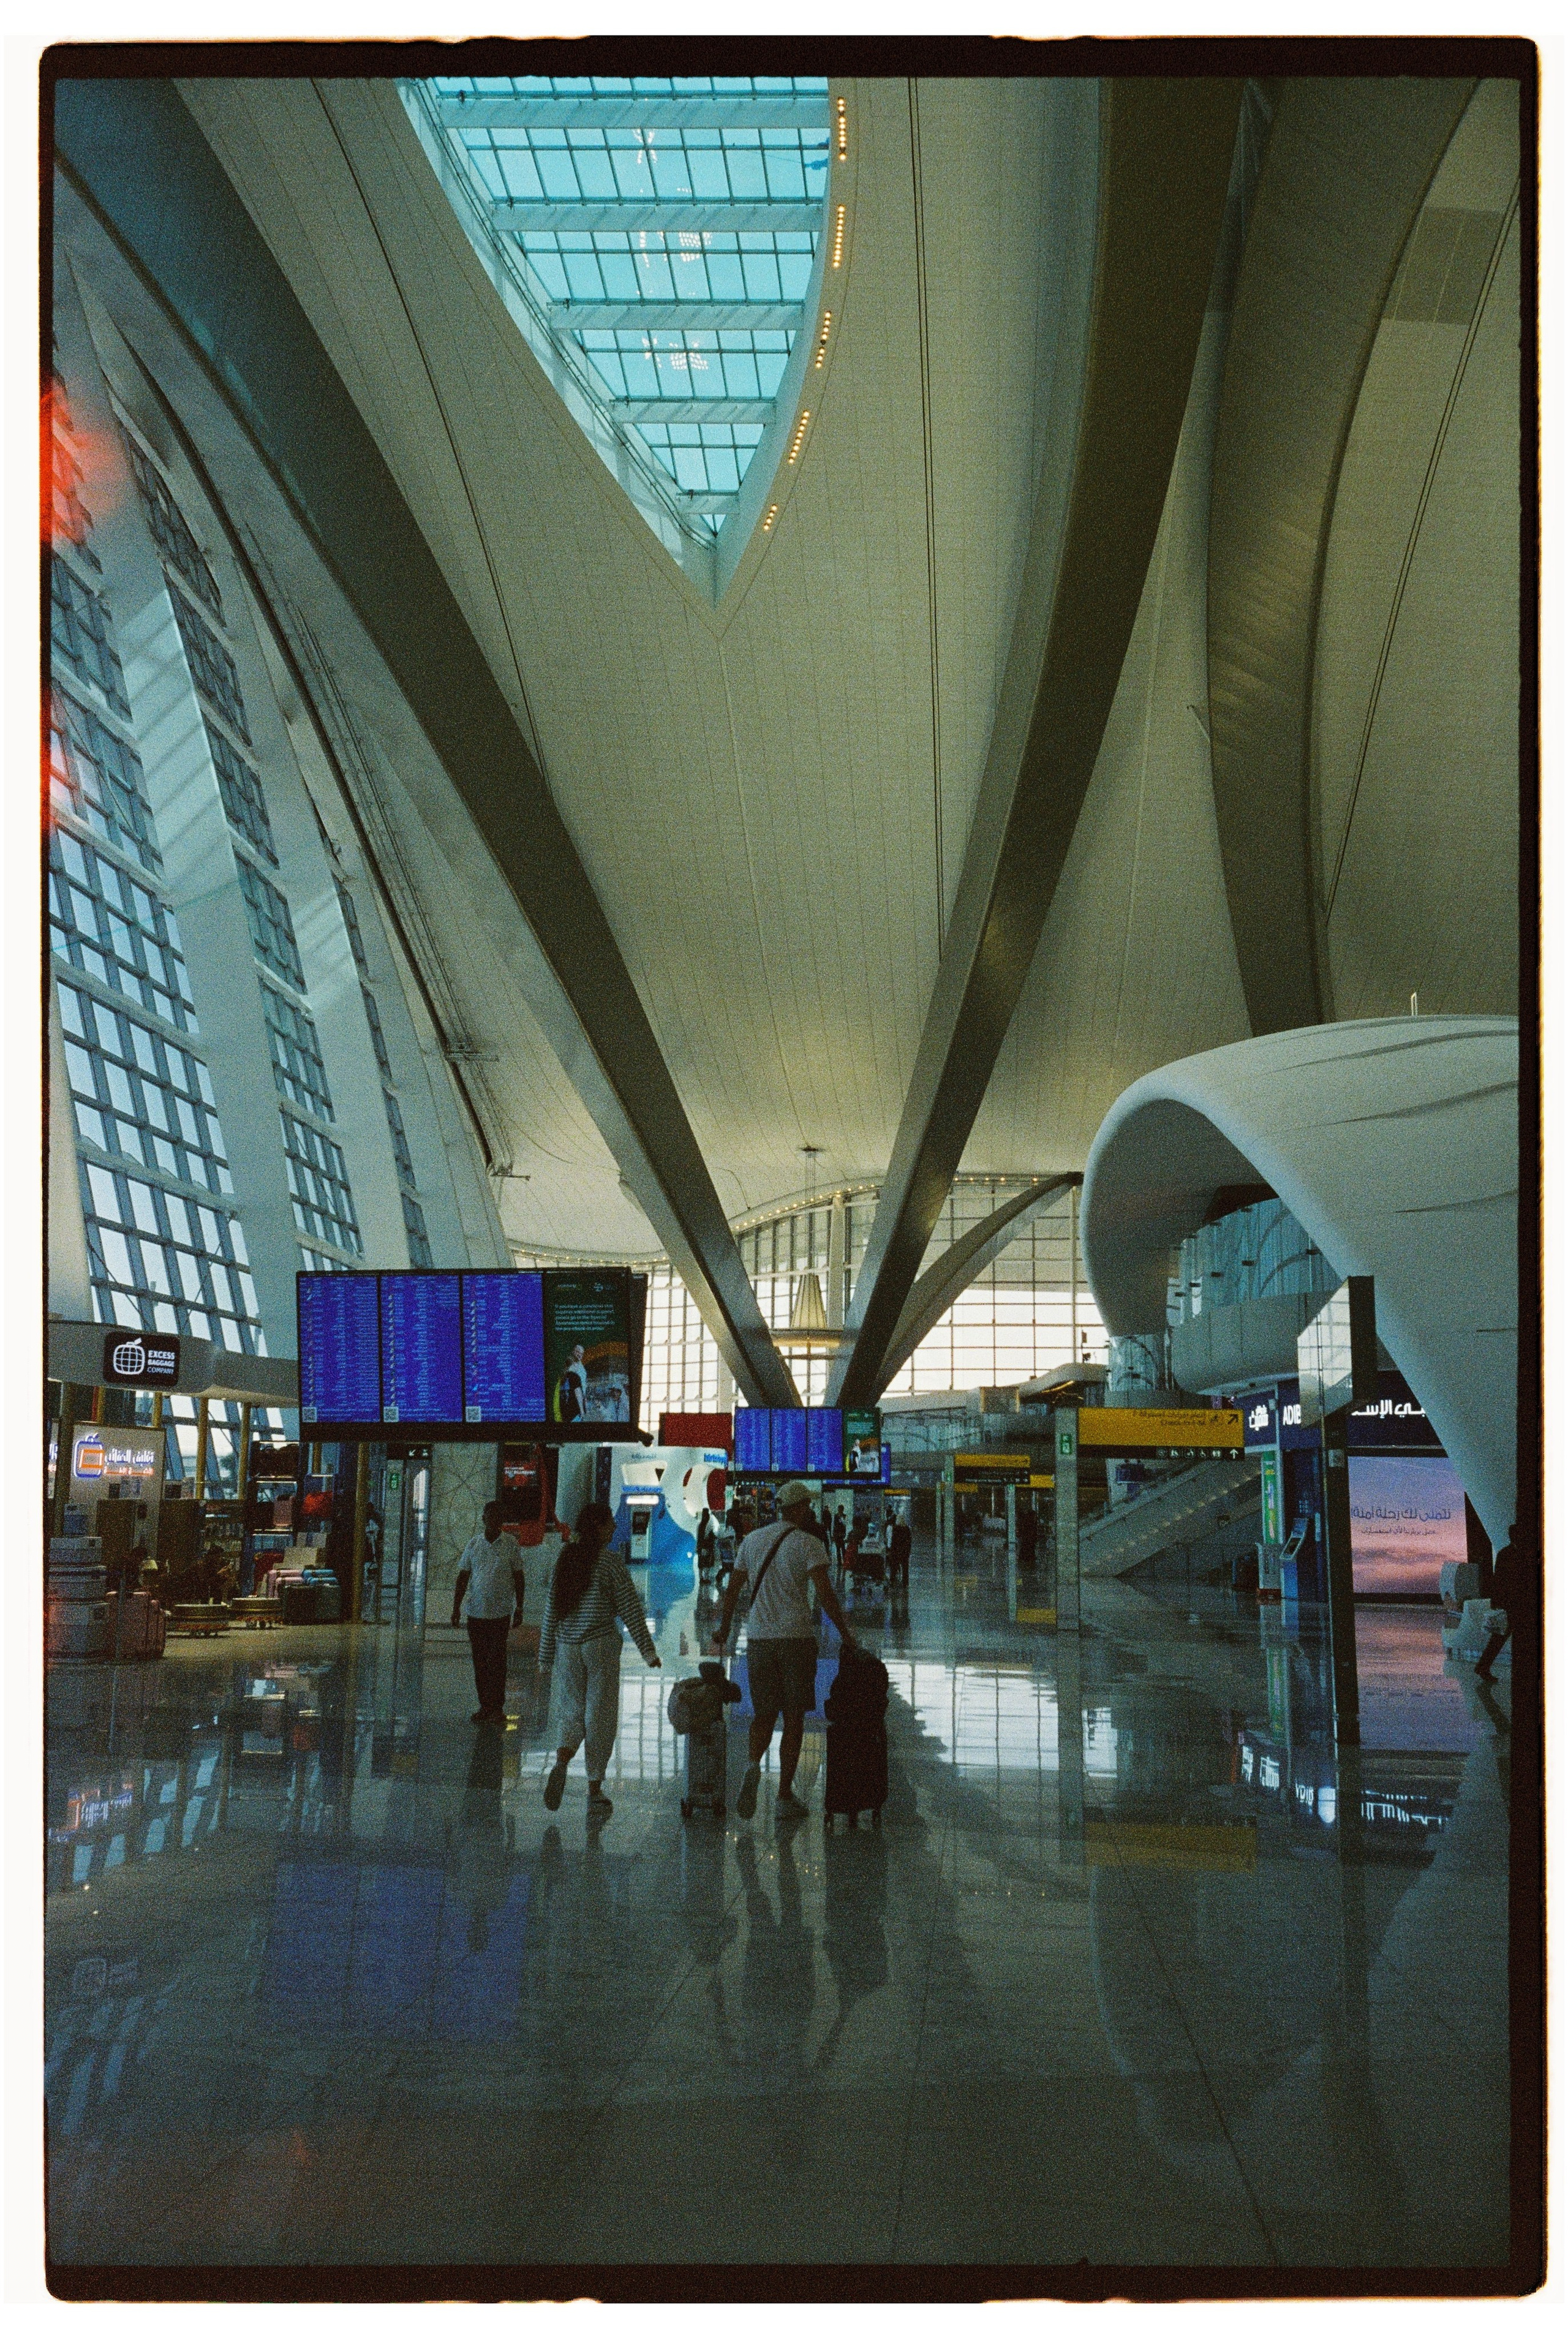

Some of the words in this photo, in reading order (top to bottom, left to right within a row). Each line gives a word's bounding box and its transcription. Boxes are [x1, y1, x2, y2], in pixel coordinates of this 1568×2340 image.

[148, 1350, 175, 1360] EXCESS
[148, 1359, 175, 1367] BAGGAGE
[1283, 1404, 1301, 1425] ADIB
[1376, 1506, 1400, 1520] رحلة
[1401, 1508, 1417, 1519] لك
